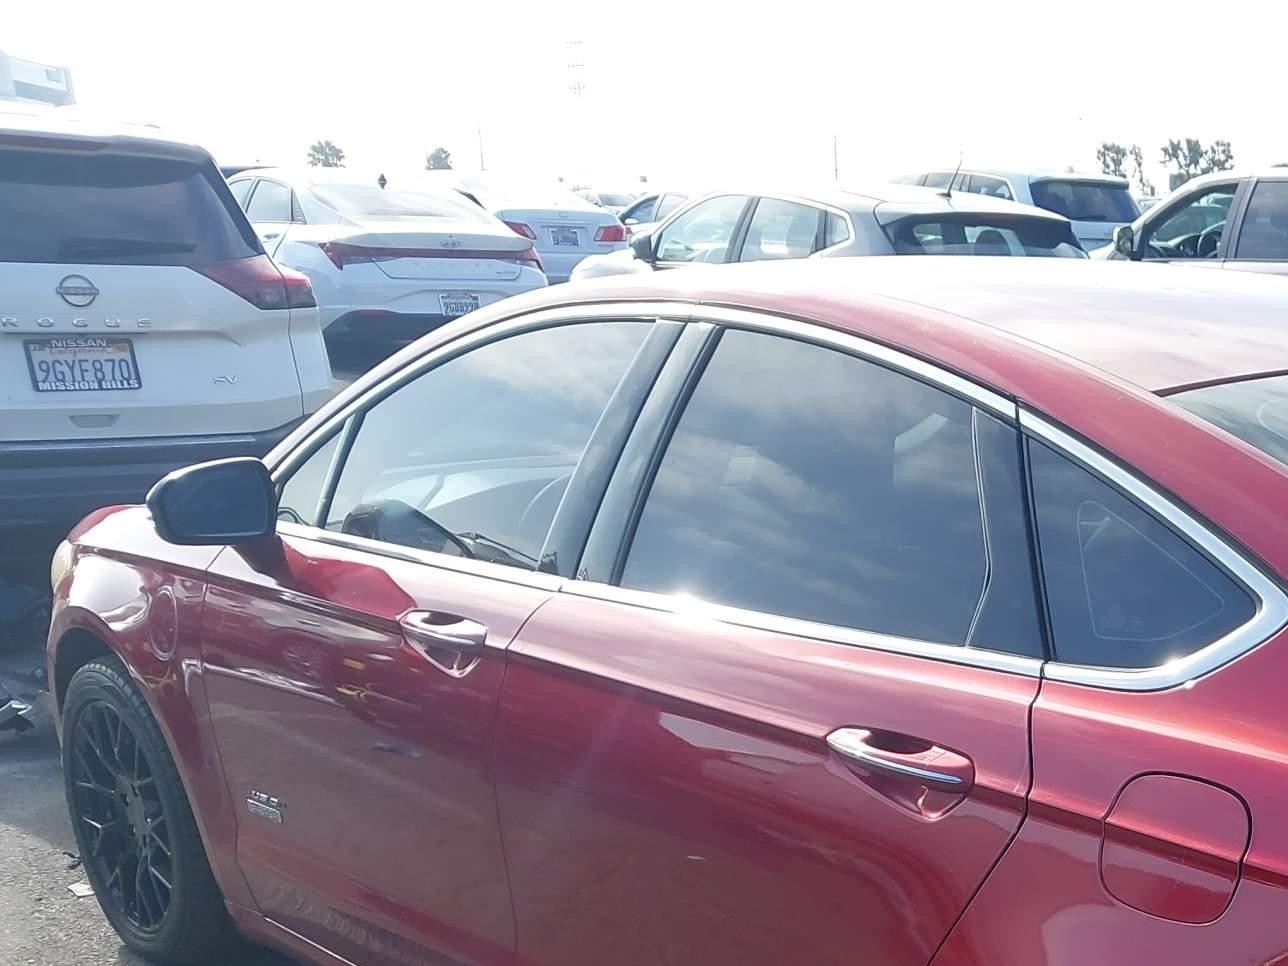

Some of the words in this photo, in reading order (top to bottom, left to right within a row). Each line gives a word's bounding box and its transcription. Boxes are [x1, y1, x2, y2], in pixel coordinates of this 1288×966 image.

[1, 317, 152, 328] ROGUE
[51, 338, 107, 348] NISSAN
[38, 358, 132, 382] 9GYF870
[38, 380, 99, 391] MISSION
[102, 379, 139, 390] HILLS
